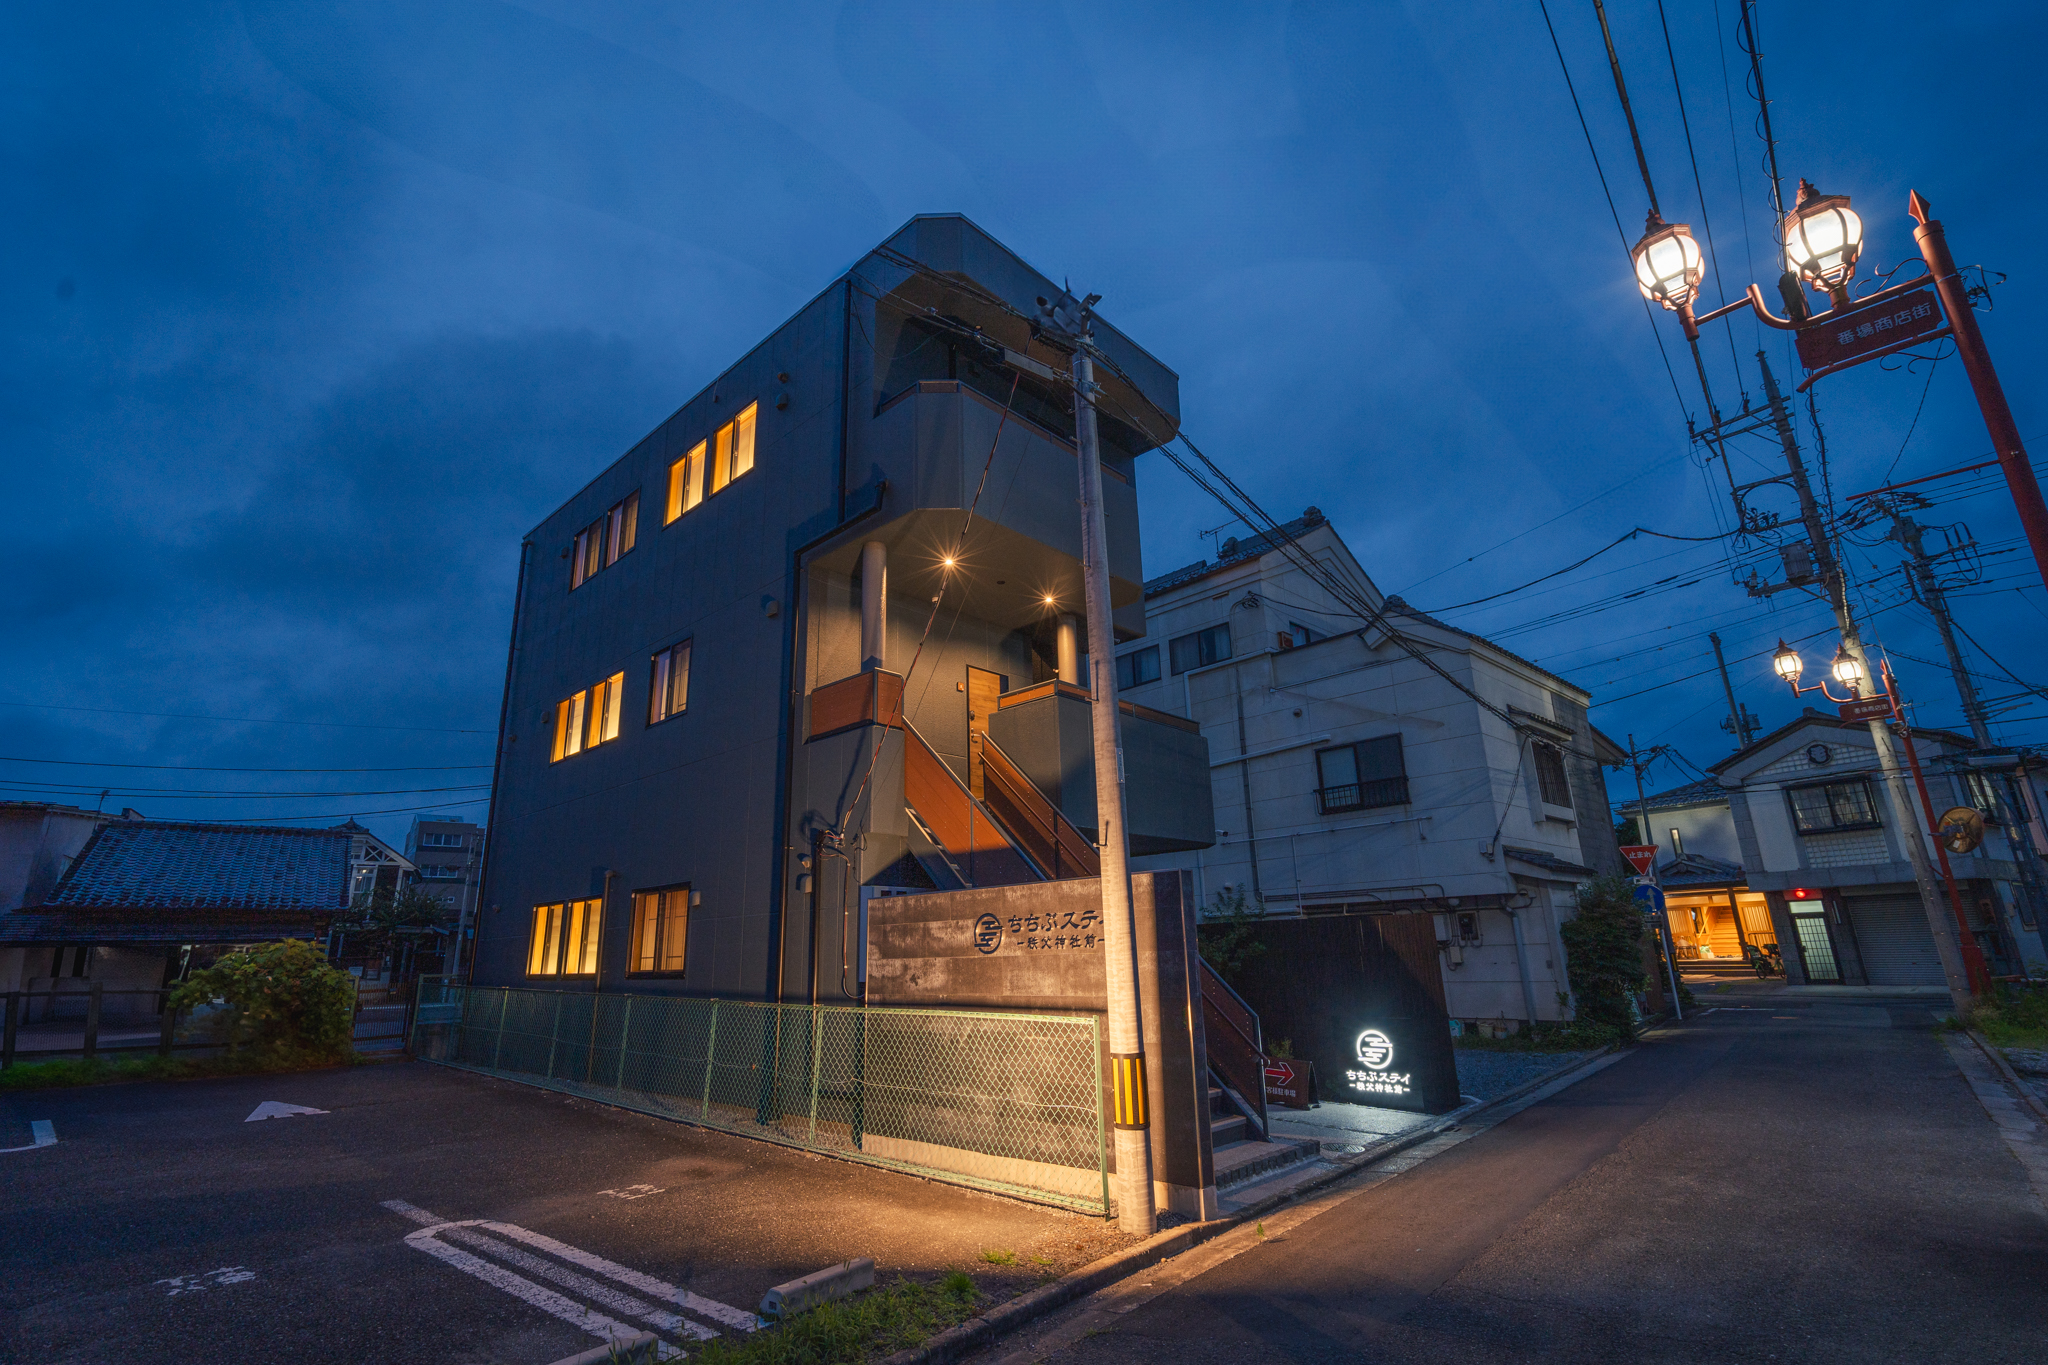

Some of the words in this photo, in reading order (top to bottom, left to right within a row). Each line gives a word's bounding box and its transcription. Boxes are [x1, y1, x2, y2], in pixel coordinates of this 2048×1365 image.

[1837, 302, 1931, 346] 番場商店街
[1629, 851, 1652, 859] 止まれ
[1008, 910, 1103, 933] ちちぶステ
[1346, 1070, 1410, 1085] ちちぶステイ
